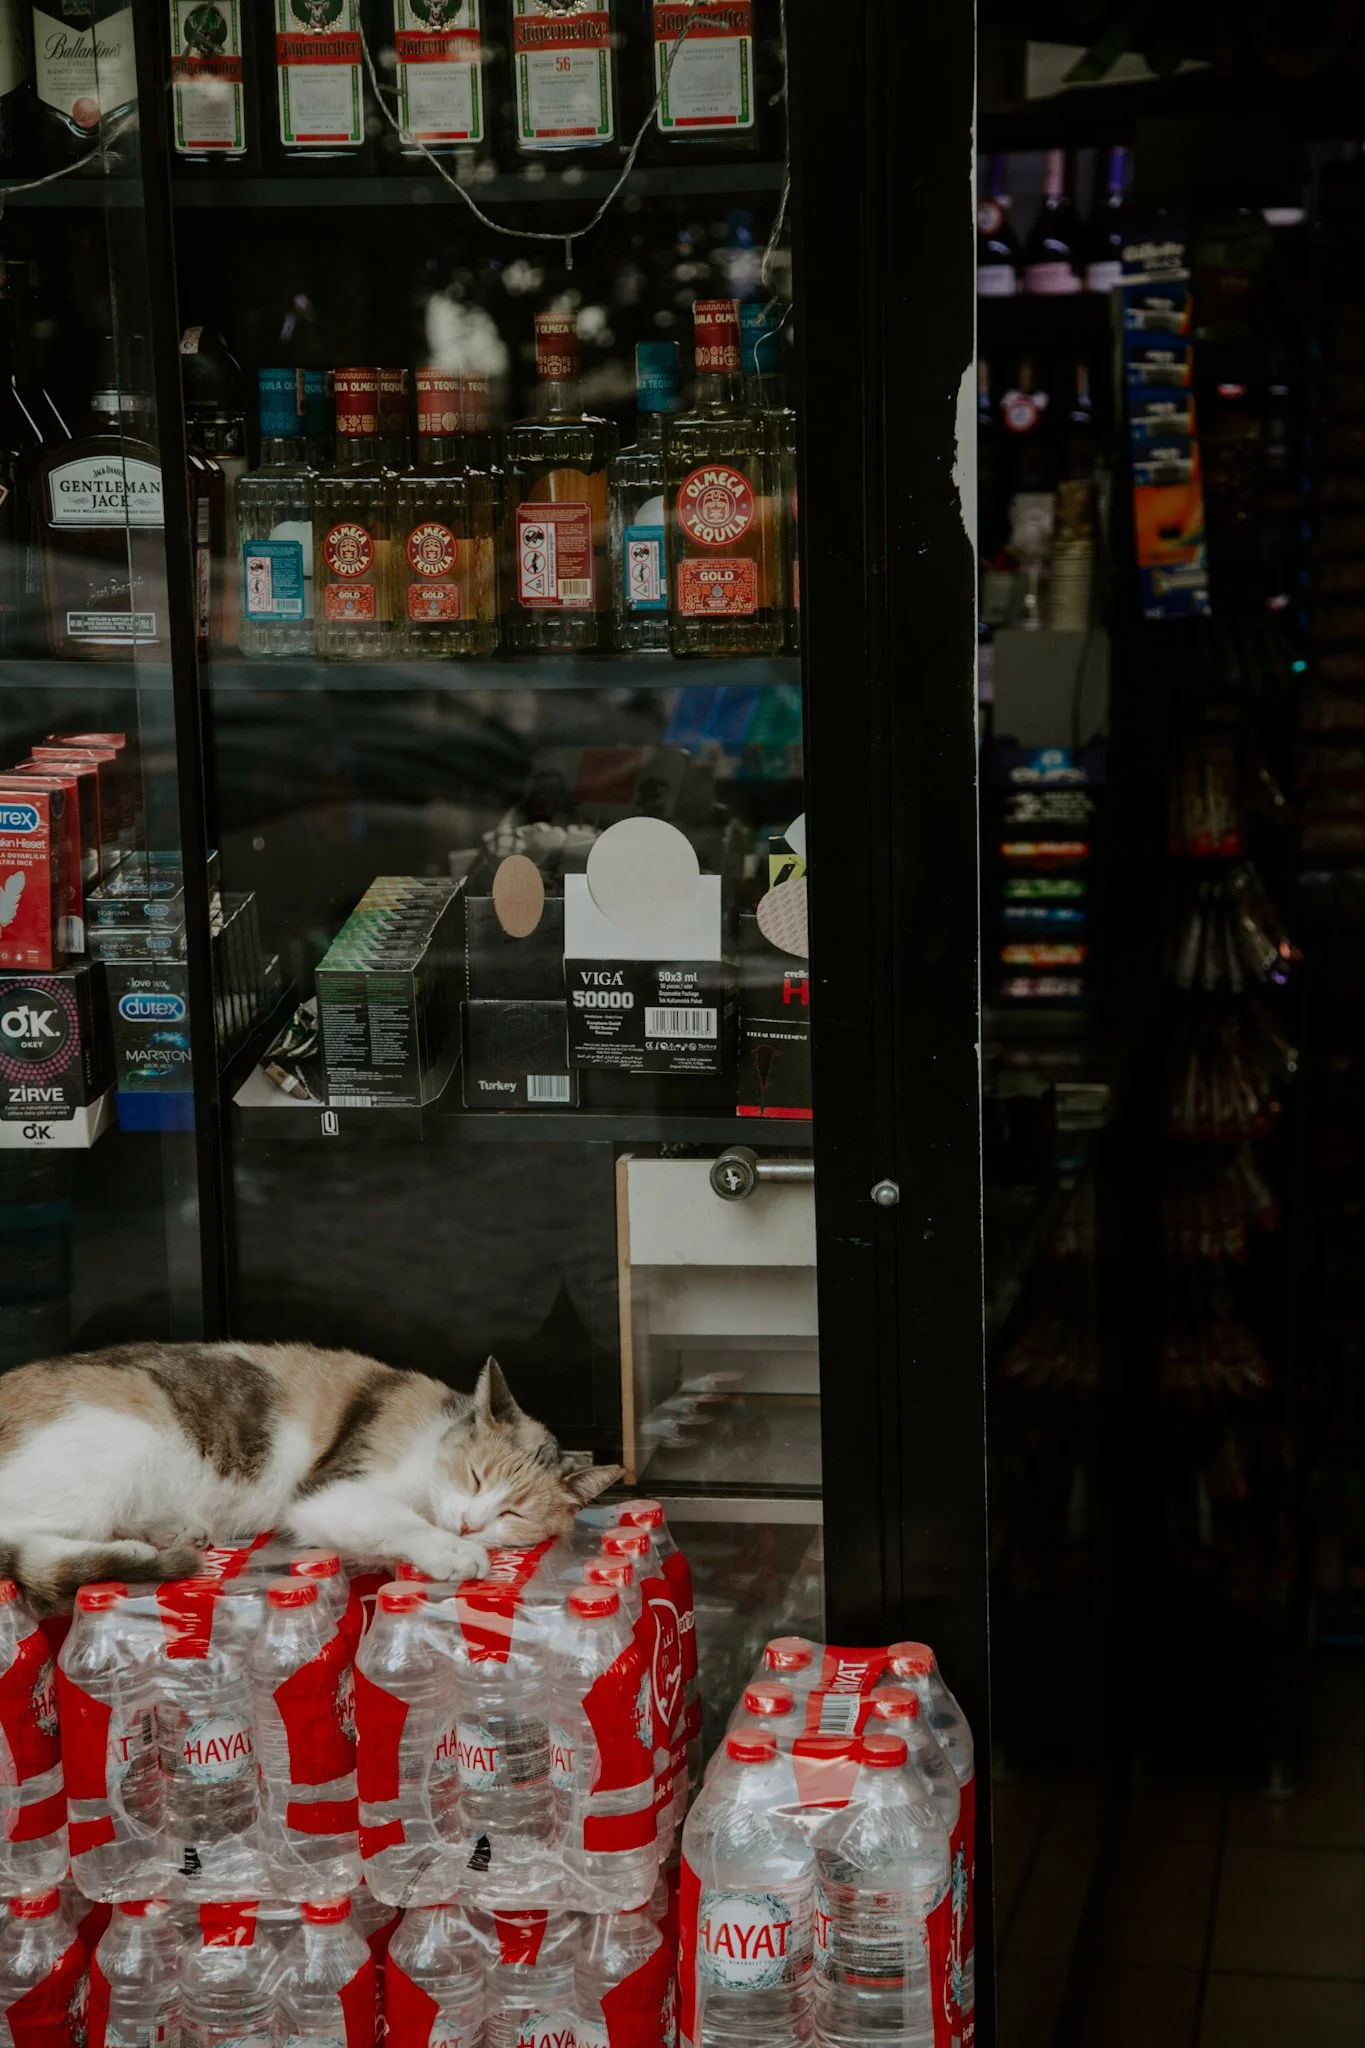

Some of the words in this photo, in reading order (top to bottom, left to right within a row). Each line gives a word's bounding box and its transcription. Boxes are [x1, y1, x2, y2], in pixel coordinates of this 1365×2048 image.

[555, 56, 571, 72] 56
[60, 480, 161, 493] GENTLEMAN
[686, 471, 746, 498] OLMECA
[92, 494, 132, 509] JACK
[328, 526, 367, 545] OLMECA
[412, 526, 451, 545] OLMECA
[687, 514, 749, 542] TEQUILA
[329, 554, 370, 574] TEQUILA
[412, 554, 454, 574] TEQUILA
[699, 571, 734, 581] GOLD
[338, 591, 361, 599] GOLD
[422, 591, 444, 599] GOLD
[16, 838, 46, 849] Hisset
[131, 977, 151, 987] love
[580, 971, 624, 985] VIGA
[658, 971, 682, 982] 50x3
[684, 971, 698, 982] ml
[572, 990, 634, 1009] 50000
[126, 998, 180, 1019] durex
[125, 1048, 192, 1063] MARATON
[8, 1085, 65, 1102] ZİRVE
[478, 1080, 517, 1093] Turkey
[699, 1918, 792, 1960] HAYAT
